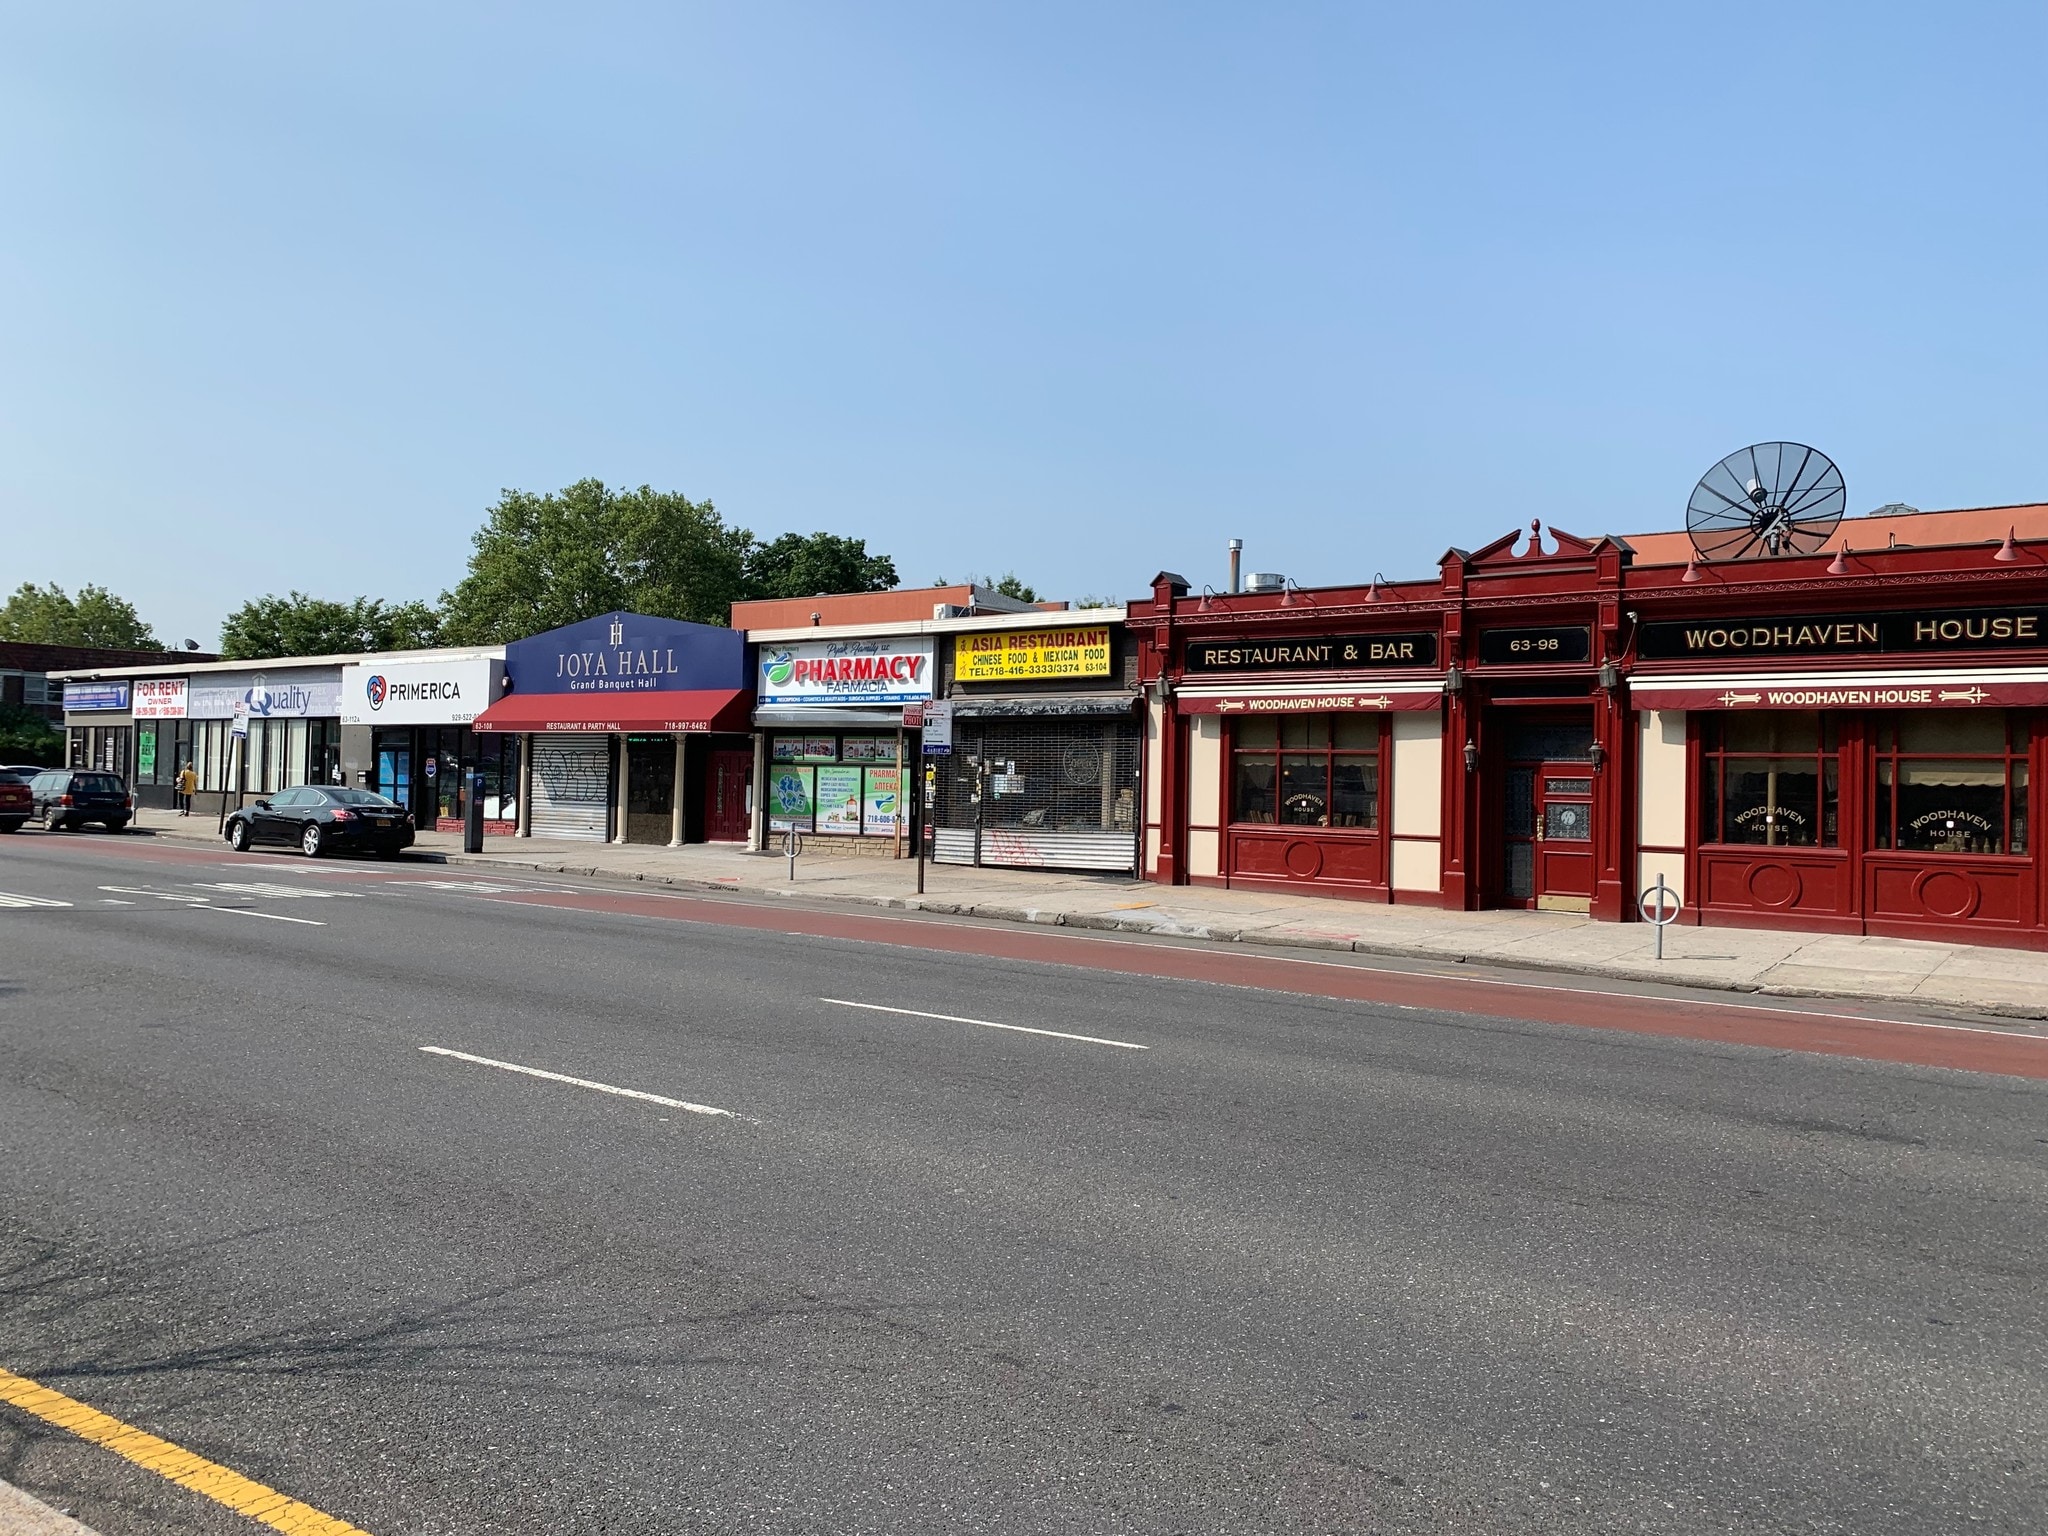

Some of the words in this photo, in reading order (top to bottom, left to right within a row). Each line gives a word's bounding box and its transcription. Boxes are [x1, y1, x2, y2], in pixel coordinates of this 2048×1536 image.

[1685, 622, 1880, 648] WOODHAVEN
[1916, 616, 2038, 640] HOUSE
[972, 637, 1002, 652] ASIA
[1009, 630, 1108, 650] RESTAURANT
[1510, 638, 1558, 652] 63-98
[850, 642, 878, 656] Family
[1204, 646, 1332, 665] RESTAURANT
[1344, 644, 1358, 660] &
[1370, 642, 1414, 660] BAR
[557, 652, 608, 678] JOYA
[618, 649, 678, 675] HALL
[972, 652, 1002, 666] CHINESE
[1008, 652, 1027, 664] FOOD
[1033, 653, 1038, 662] &
[1044, 650, 1078, 662] MEXICAN
[1084, 648, 1104, 660] FOOD
[794, 656, 921, 682] PHARMACY
[969, 664, 1079, 676] TEL:718-416-3333/3374
[1086, 663, 1106, 672] 63-104
[137, 682, 155, 696] FOR
[159, 681, 185, 696] RENT
[390, 682, 460, 700] PRIMERICA
[571, 679, 595, 690] Grand
[599, 679, 634, 690] Banquet
[638, 678, 656, 688] Hall
[826, 680, 888, 693] FARMACIA
[245, 685, 311, 716] Quality
[1249, 698, 1315, 710] WOODHAVEN
[1317, 697, 1355, 708] HOUSE
[1768, 690, 1873, 704] WOODHAVEN
[1874, 690, 1932, 703] HOUSE
[1285, 794, 1324, 806] WOODHAVEN
[867, 814, 906, 824] 718-606-85
[1734, 806, 1806, 825] WOODHAVEN
[1910, 810, 1992, 831] WOODHAVEN
[1930, 830, 1971, 838] HOUSE
